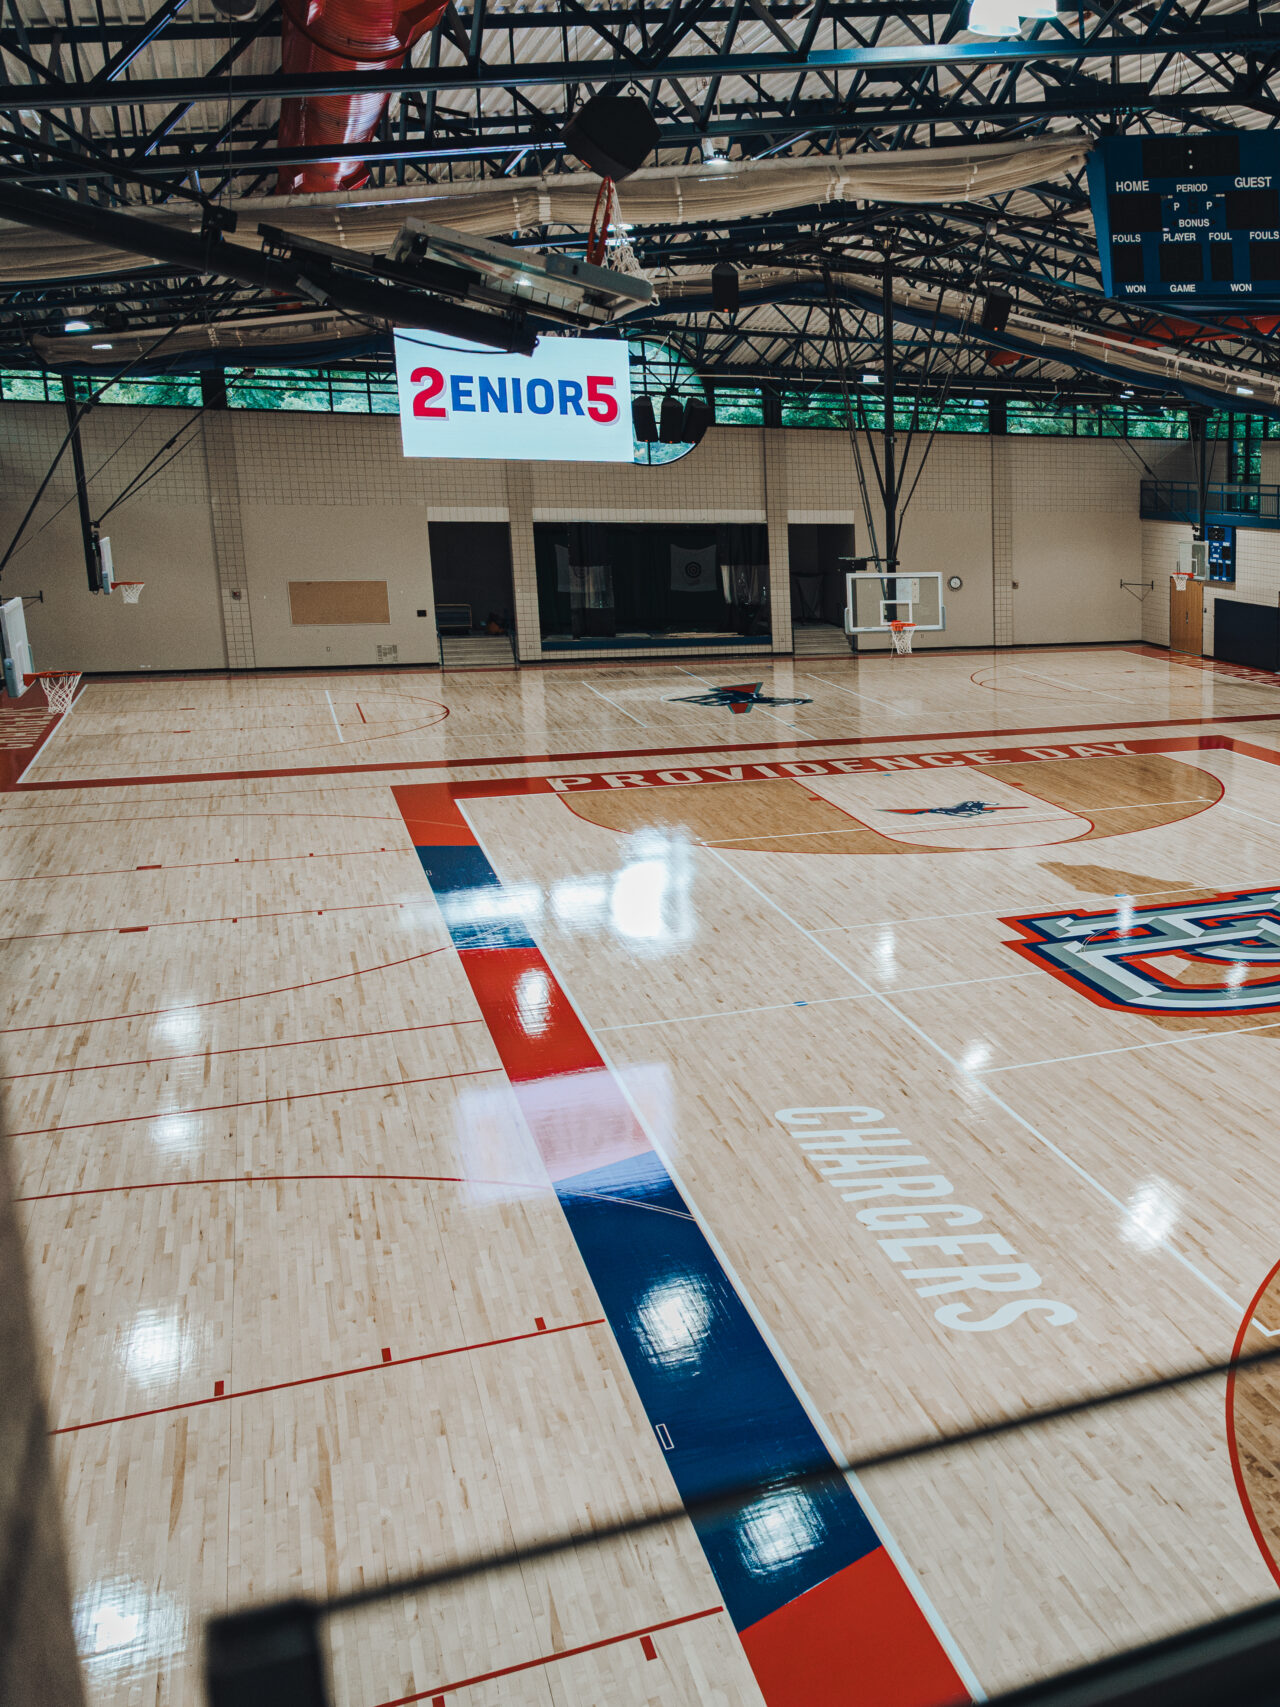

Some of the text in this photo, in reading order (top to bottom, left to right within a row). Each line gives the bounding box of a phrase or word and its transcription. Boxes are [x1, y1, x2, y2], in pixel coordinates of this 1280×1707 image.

[1115, 177, 1272, 192] HOME GUEST
[1176, 184, 1208, 192] PERIOD
[1173, 201, 1212, 211] P P
[1179, 219, 1210, 227] BONUS
[1112, 231, 1280, 243] FOULS PLAYER FOUL FOULS
[1125, 283, 1252, 293] WON GAME WON
[410, 366, 621, 426] 2ENIOR5
[545, 742, 1137, 792] PROVIDENCE DAY
[774, 1105, 1078, 1332] CHARGERS
